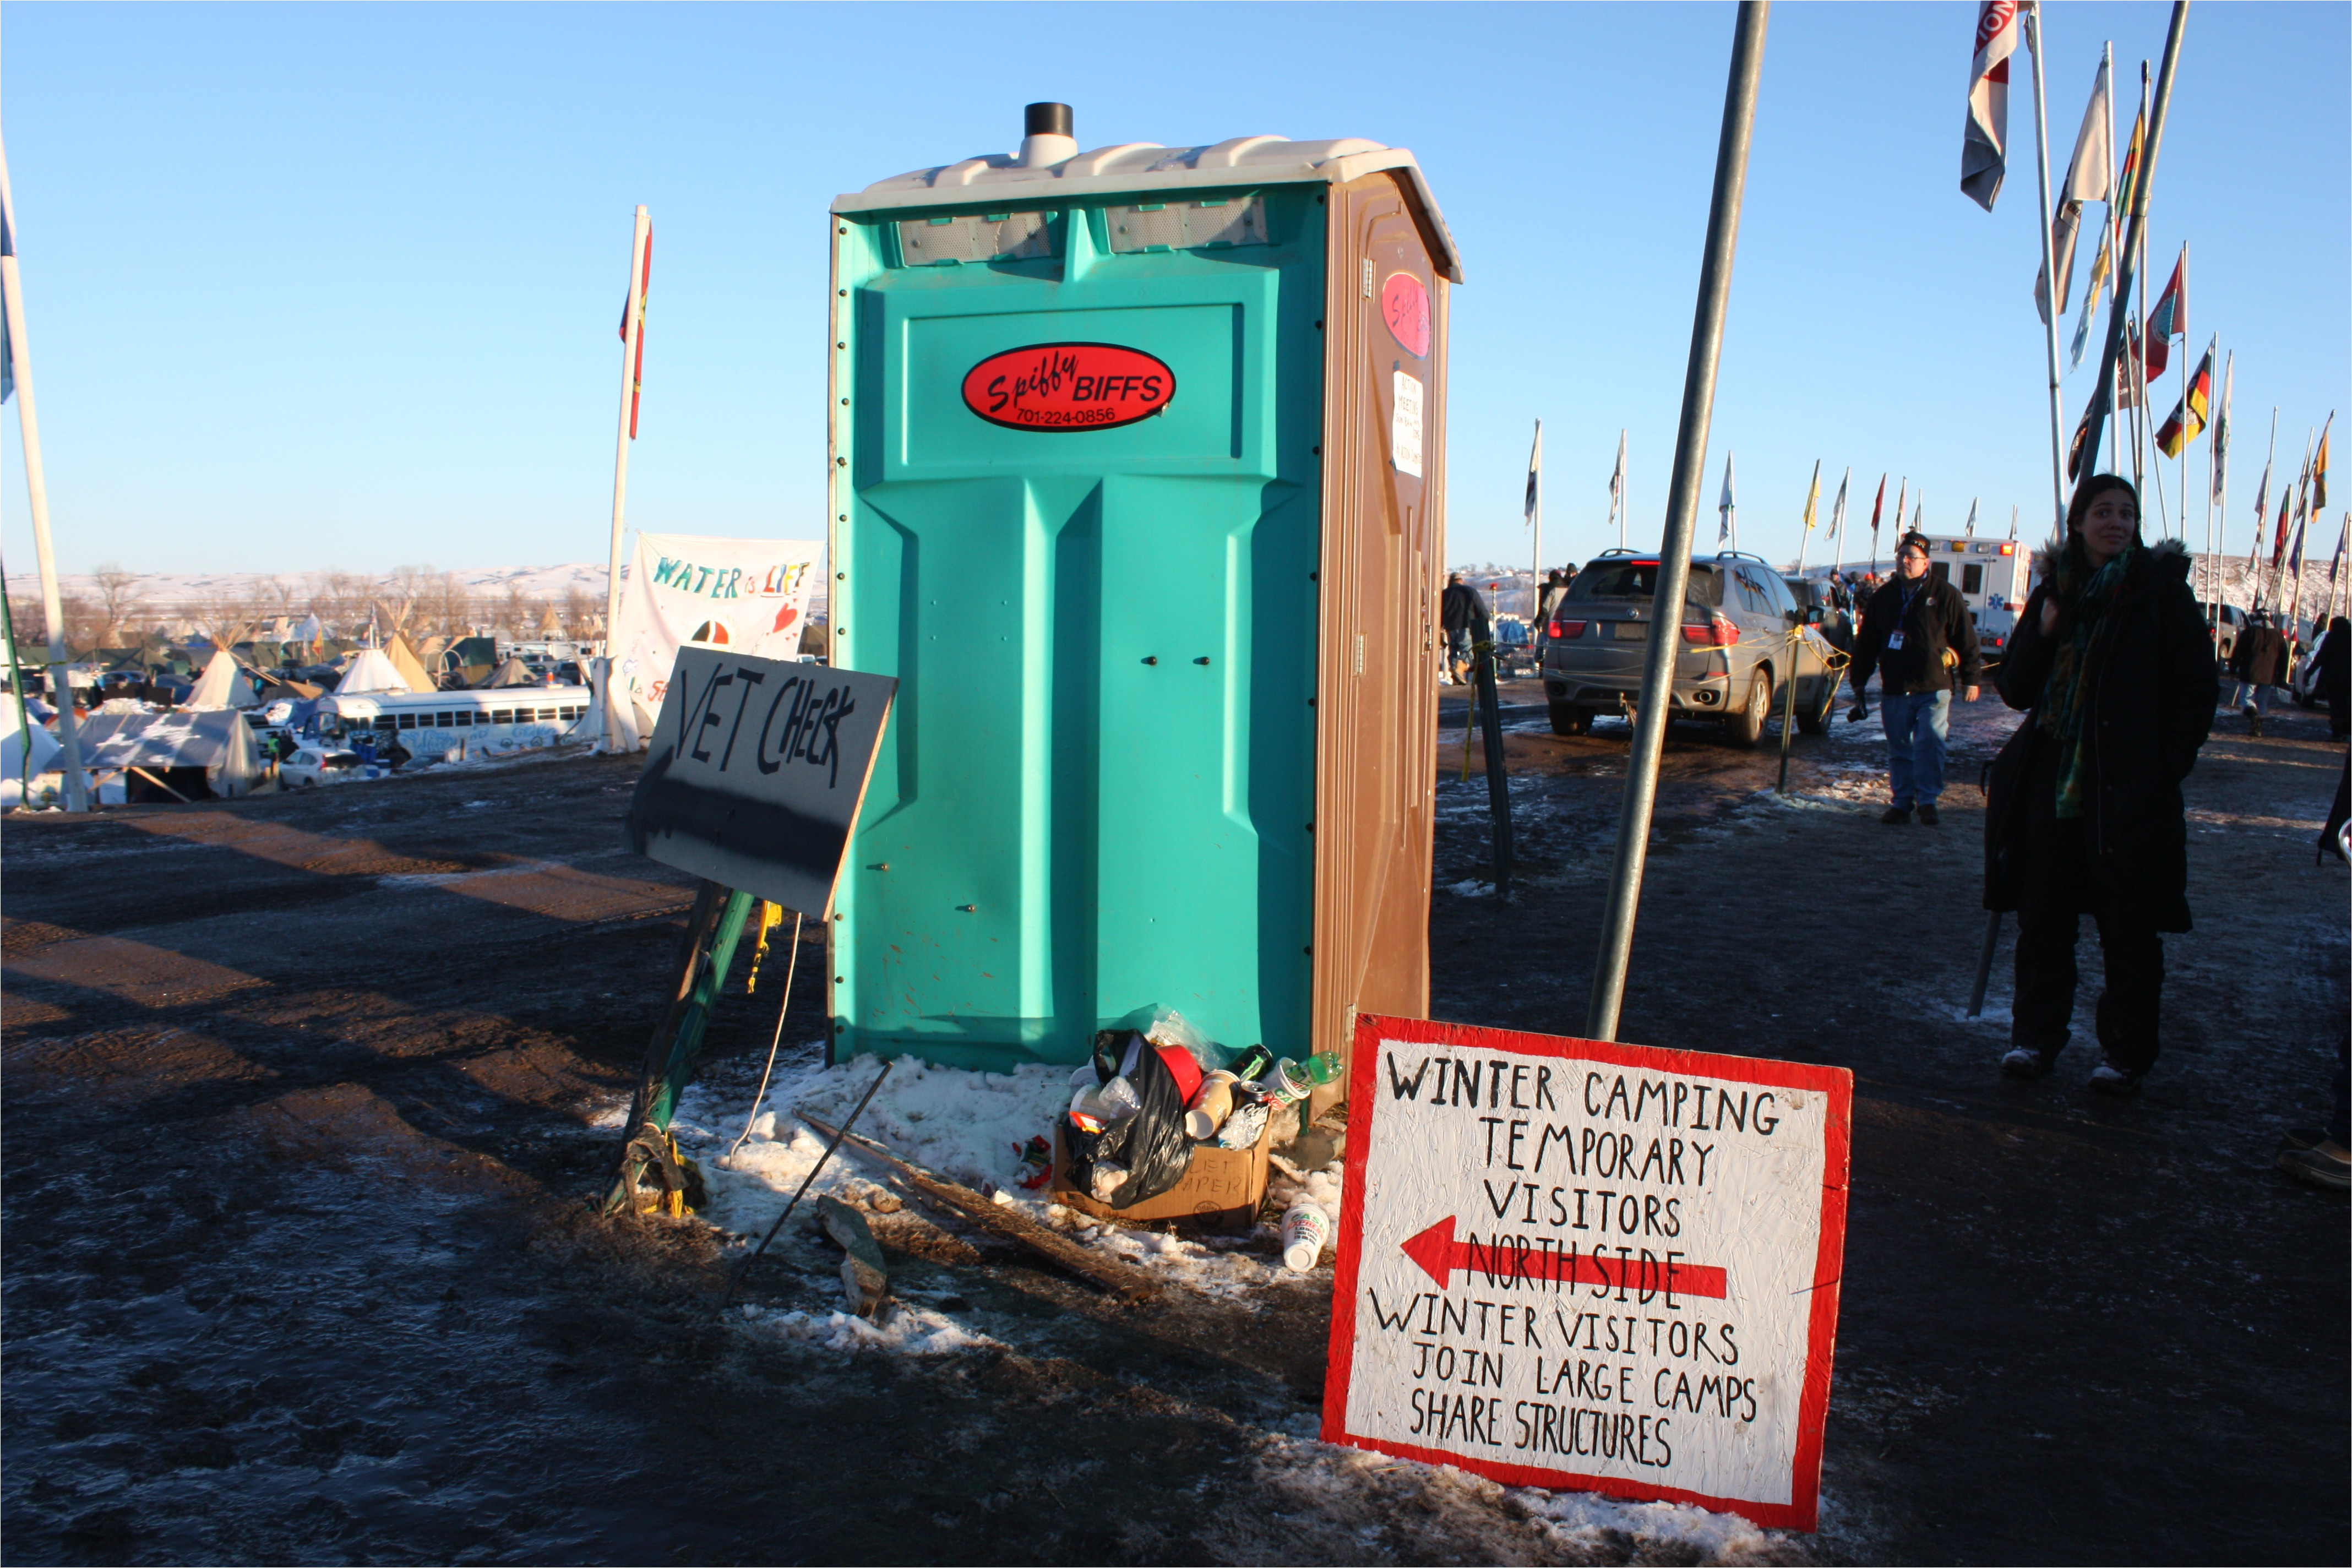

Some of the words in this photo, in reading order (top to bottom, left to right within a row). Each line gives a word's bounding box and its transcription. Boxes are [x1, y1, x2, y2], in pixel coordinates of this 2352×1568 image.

[987, 350, 1079, 412] Spiffy
[1016, 407, 1116, 424] 701-224-0856
[1072, 375, 1162, 401] BIFFS
[653, 557, 742, 599] WATER
[762, 562, 810, 594] LIFE
[676, 663, 765, 772] VET
[758, 676, 855, 790] CHECK
[1386, 1051, 1556, 1112] WINTER
[1585, 1071, 1781, 1136] CAMPING
[1173, 1176, 1241, 1195] APER
[1478, 1116, 1715, 1187] TEMPORARY
[1483, 1179, 1681, 1238] VISITORS
[1467, 1232, 1576, 1295] NORTH
[1592, 1244, 1685, 1310] SIDE
[1369, 1287, 1543, 1350] WINTER
[1557, 1309, 1740, 1366] VISITORS
[1412, 1342, 1504, 1389] JOIN
[1536, 1355, 1635, 1404] LARGE
[1654, 1368, 1757, 1423] CAMPS
[1411, 1387, 1502, 1446] SHARE
[1514, 1400, 1672, 1469] STRUCTURES
